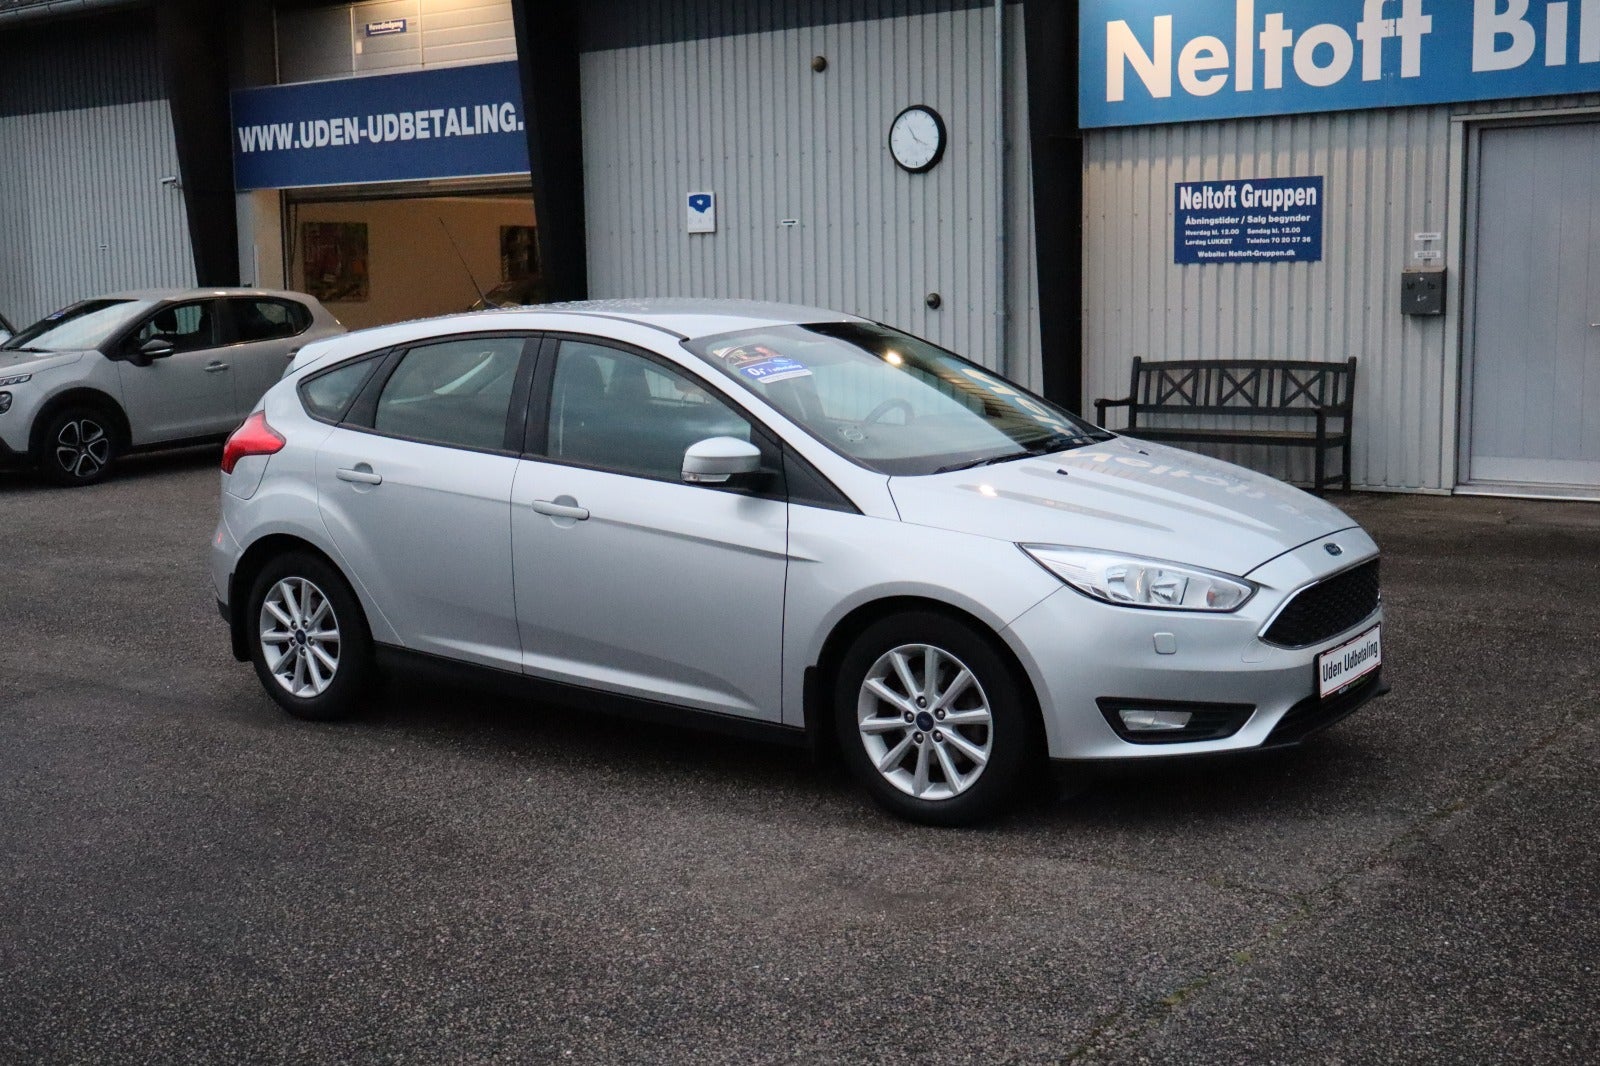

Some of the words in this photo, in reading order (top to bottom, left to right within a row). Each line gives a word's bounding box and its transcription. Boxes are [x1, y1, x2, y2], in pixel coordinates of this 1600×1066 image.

[1106, 0, 1432, 102] Neltoft
[238, 102, 524, 152] WWW.UDEN-UDBETALING.
[1180, 184, 1236, 210] Neltoft
[1241, 183, 1317, 212] Gruppen
[1185, 215, 1240, 226] Åbningstider
[1247, 215, 1266, 225] Salg
[1268, 214, 1311, 224] begynder
[1198, 250, 1227, 258] Website:
[1228, 249, 1296, 258] Neltoft-Gruppen.dk
[1322, 660, 1342, 682] Uden
[1344, 640, 1378, 672] Udbetaling
